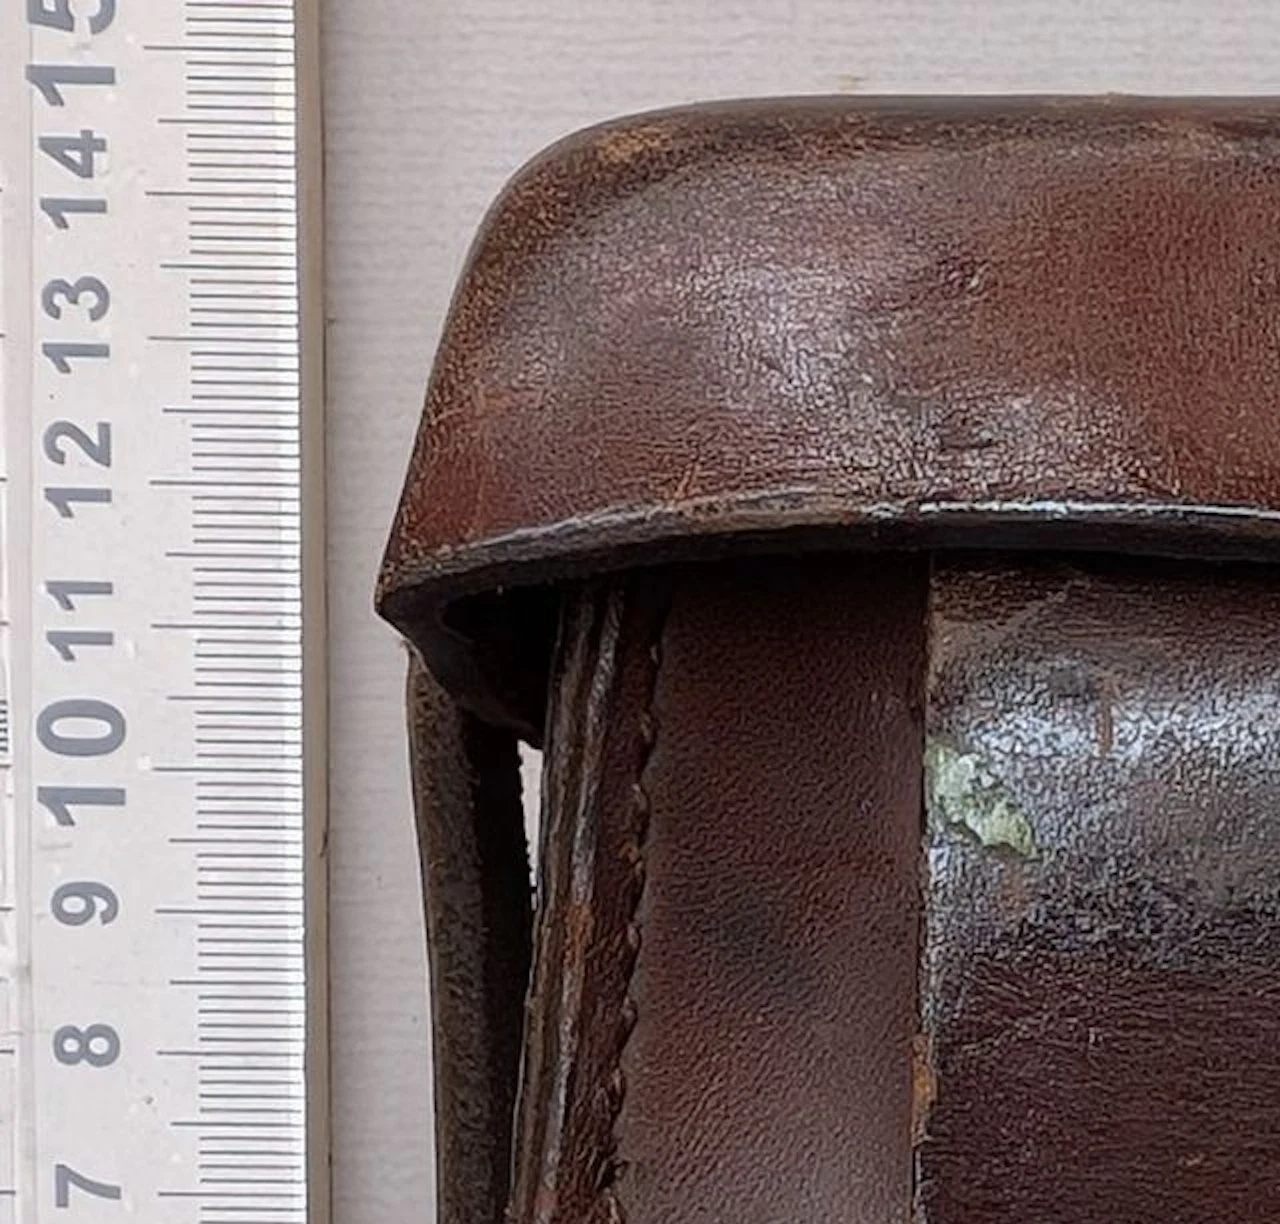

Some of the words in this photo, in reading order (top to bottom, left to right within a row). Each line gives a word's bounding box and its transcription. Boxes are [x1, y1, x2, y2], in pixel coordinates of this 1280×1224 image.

[38, 130, 107, 229] 14
[42, 277, 110, 374] 13
[44, 421, 112, 518] 12
[45, 581, 114, 661] 11
[37, 700, 126, 826] 10
[51, 882, 118, 926] 9
[53, 1024, 120, 1067] 8
[55, 1164, 121, 1208] 7
